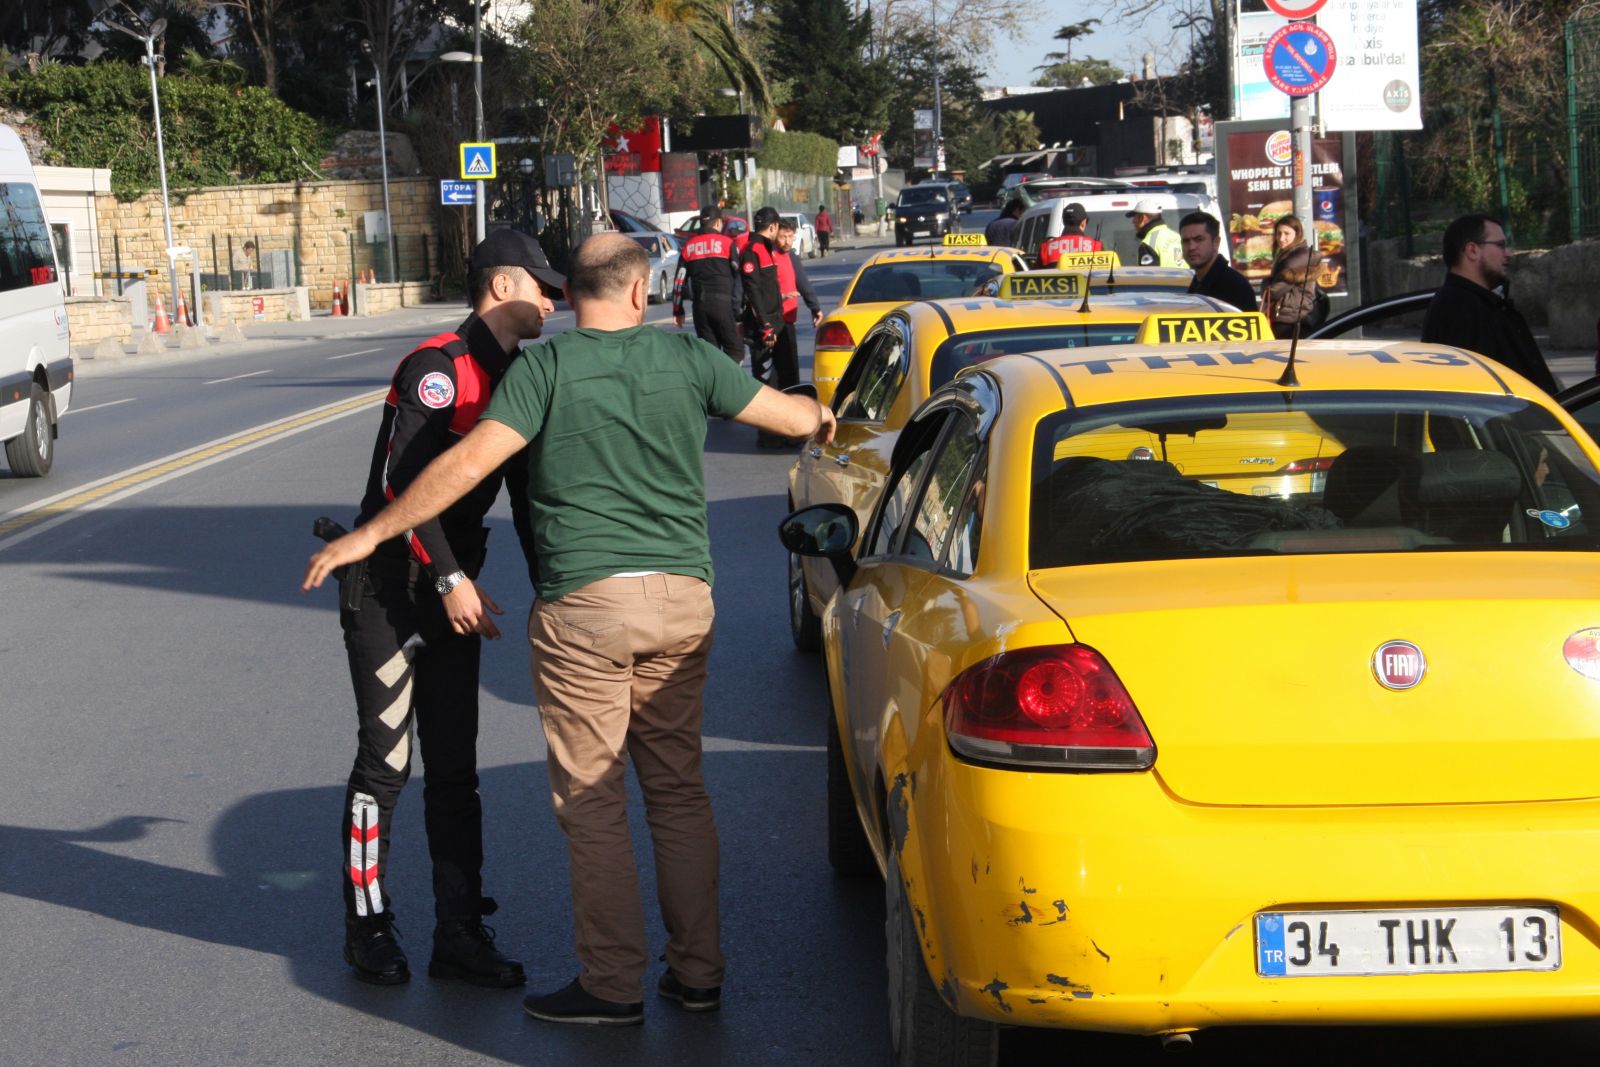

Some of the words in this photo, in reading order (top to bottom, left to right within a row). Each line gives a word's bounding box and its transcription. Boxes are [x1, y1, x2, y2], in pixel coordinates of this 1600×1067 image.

[1352, 24, 1384, 35] hdiye
[1355, 36, 1383, 49] xis
[1291, 76, 1327, 93] YPILMAZ
[1231, 167, 1281, 181] WHOPPER
[1060, 350, 1309, 375] THK
[1347, 350, 1472, 367] 13
[1386, 654, 1416, 676] FIAT
[1264, 949, 1283, 963] TR
[1288, 920, 1341, 967] 34
[1377, 917, 1458, 965] THK
[1499, 915, 1550, 962] 13
